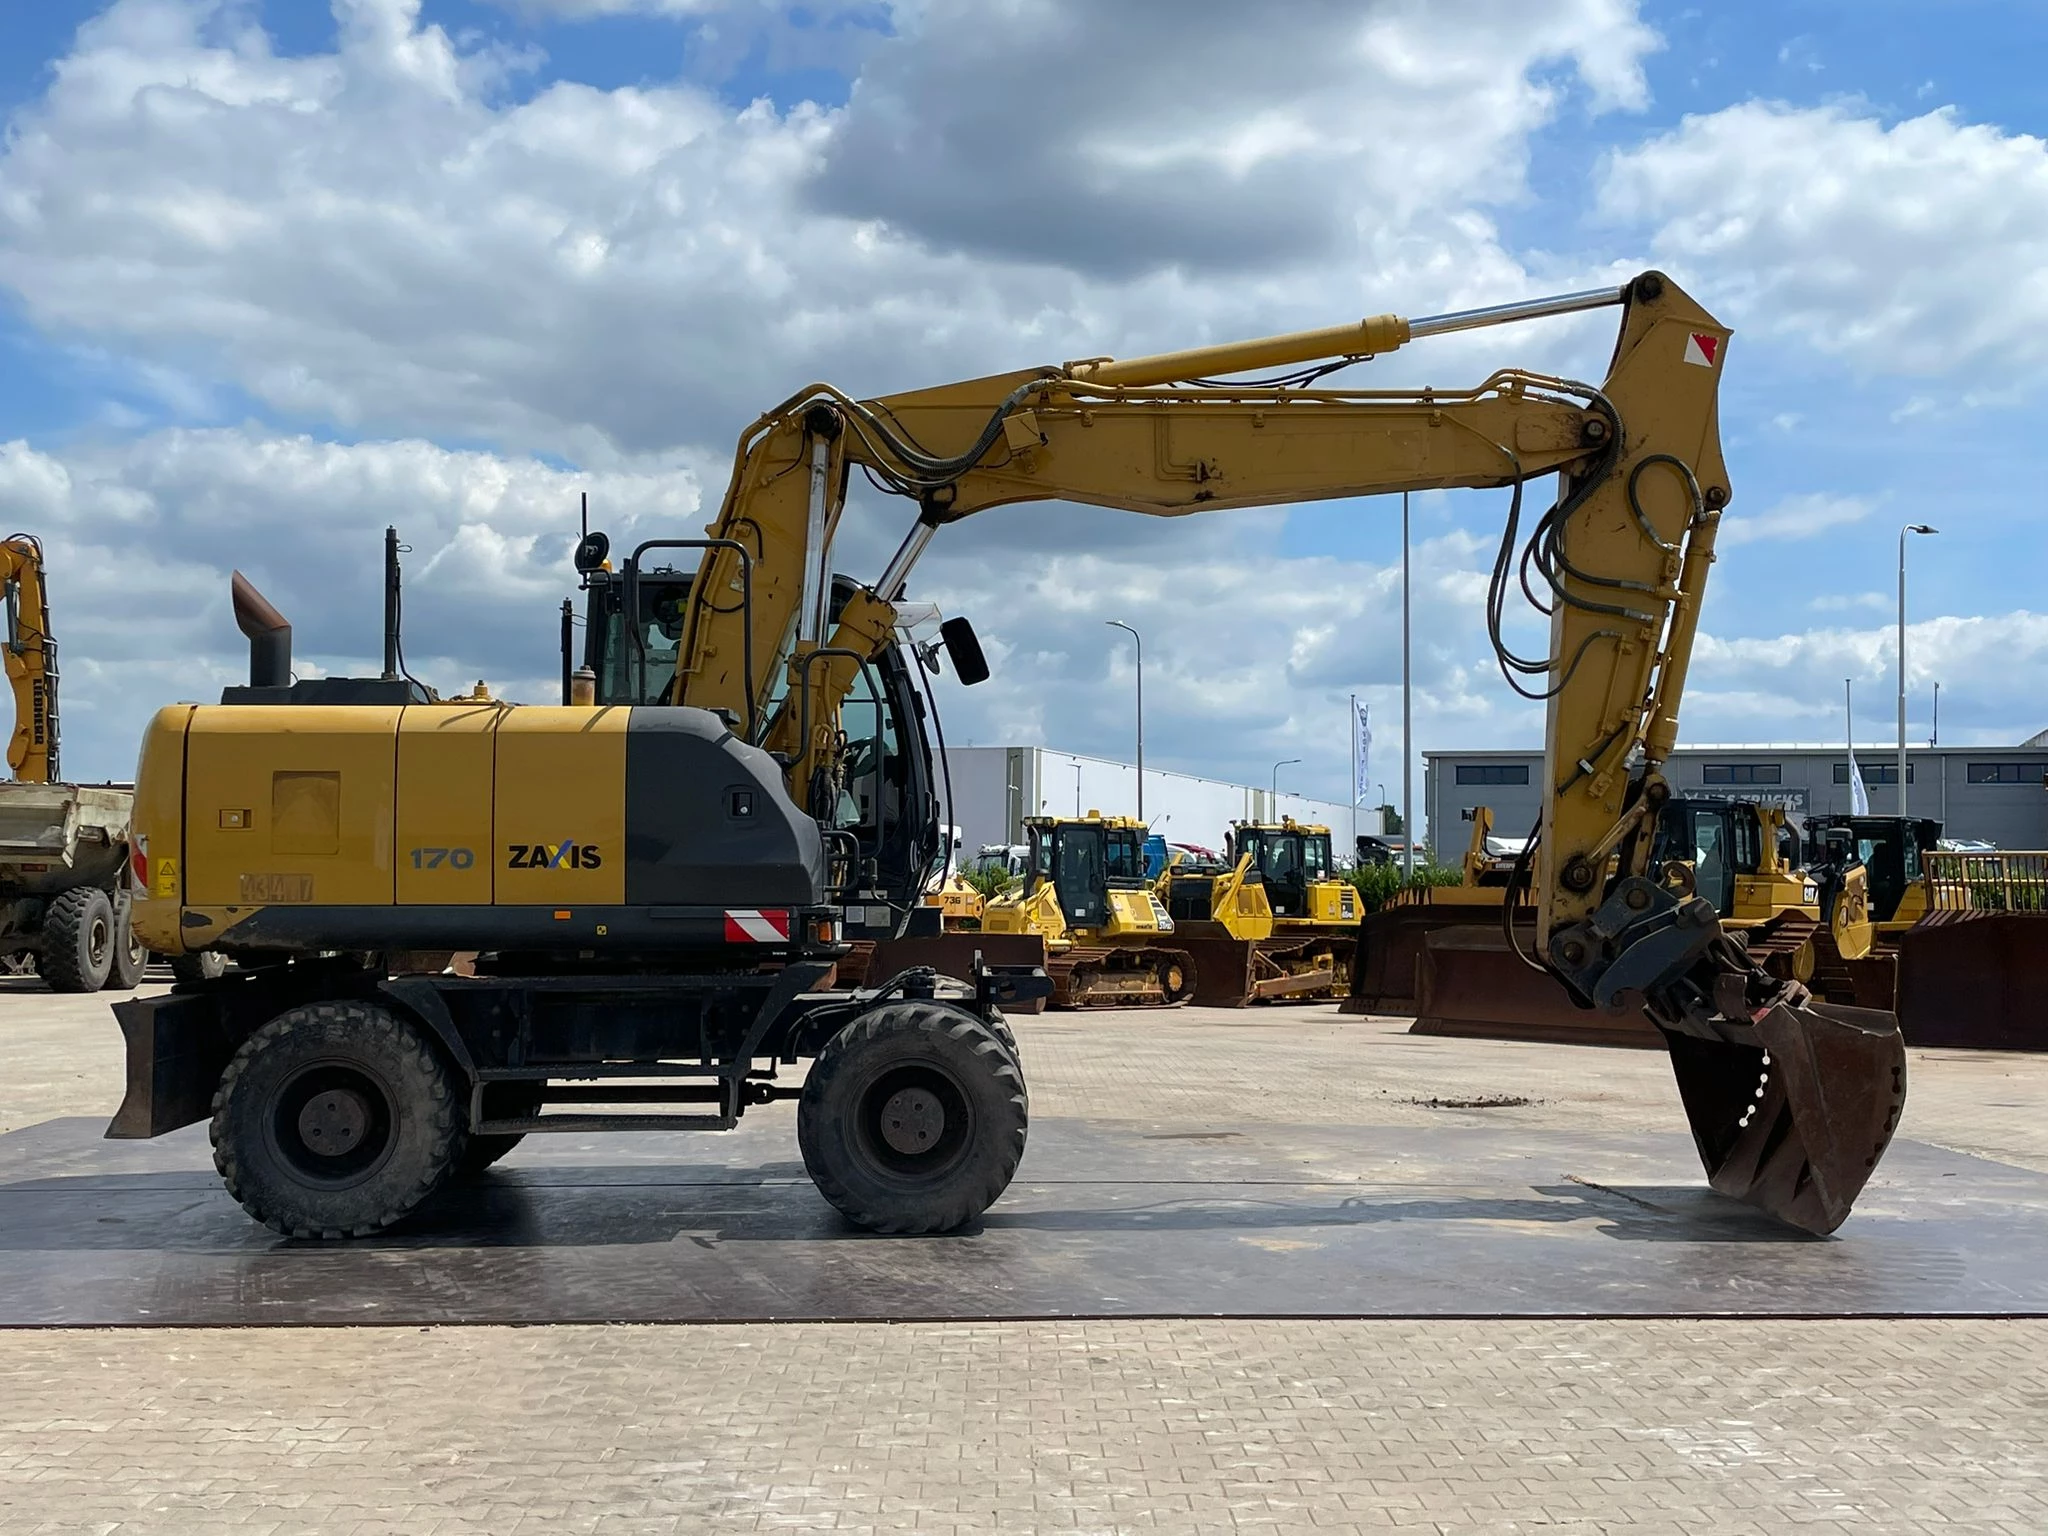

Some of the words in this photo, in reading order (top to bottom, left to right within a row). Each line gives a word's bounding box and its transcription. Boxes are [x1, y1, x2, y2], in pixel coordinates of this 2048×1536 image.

[33, 679, 44, 745] LIEBHERR
[411, 848, 474, 869] 170
[508, 839, 602, 869] ZAXIS
[944, 896, 961, 905] 736
